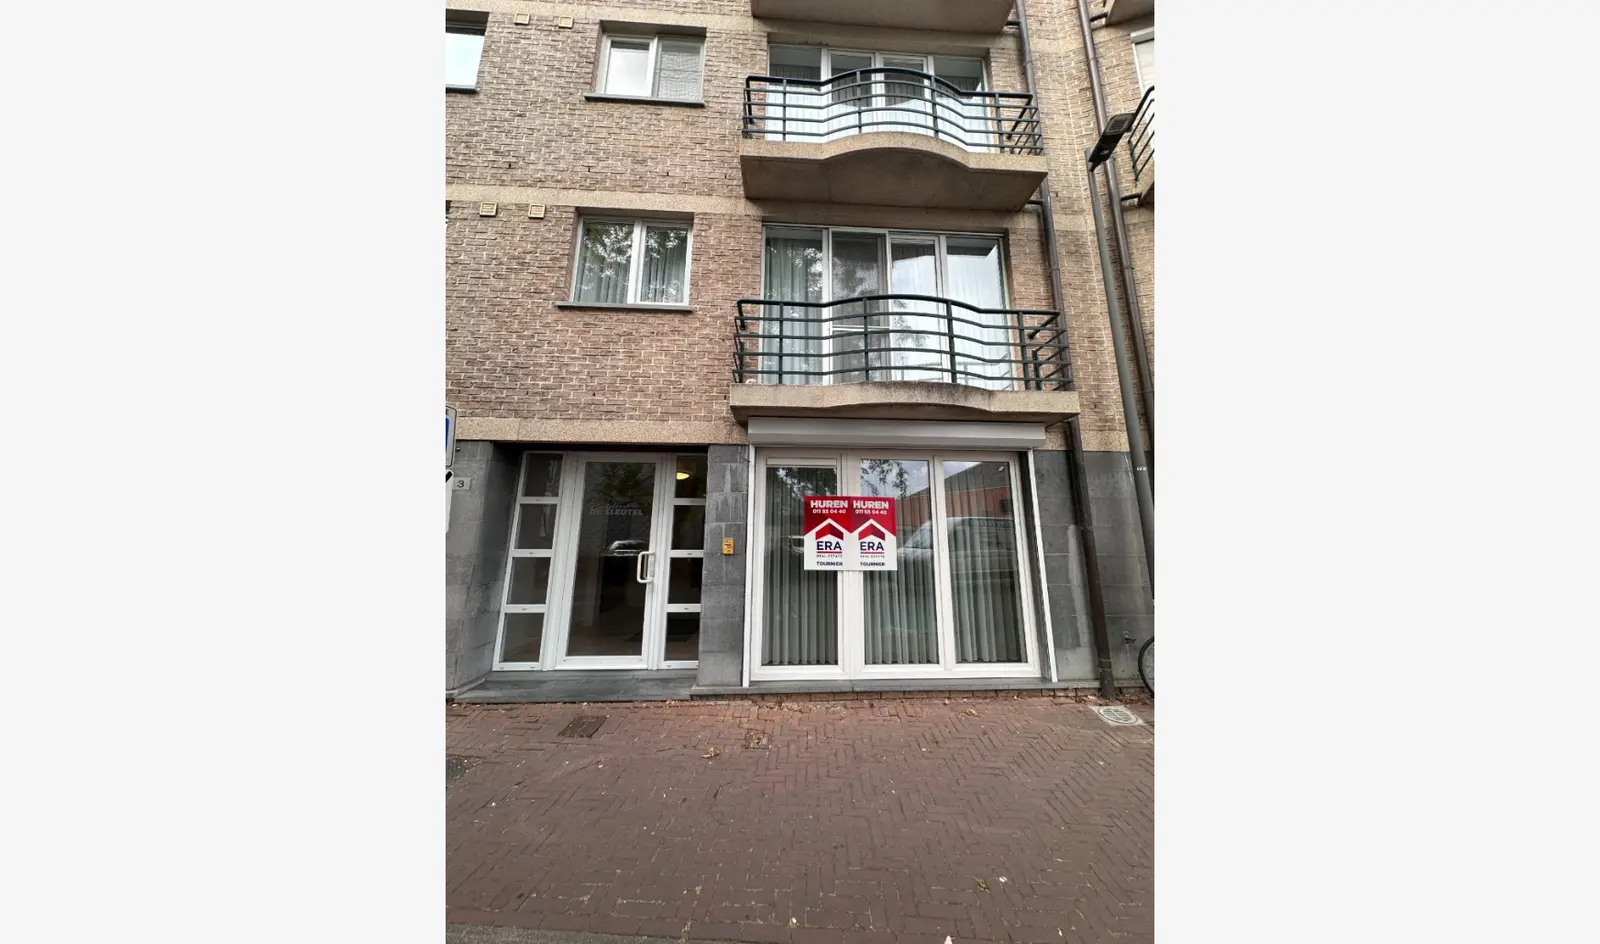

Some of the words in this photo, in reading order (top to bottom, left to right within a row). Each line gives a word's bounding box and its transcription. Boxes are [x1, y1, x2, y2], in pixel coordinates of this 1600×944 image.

[457, 480, 465, 488] 3
[810, 500, 848, 508] HUREN
[853, 501, 889, 509] HUREN
[816, 541, 842, 550] ERA
[860, 541, 884, 551] ERA
